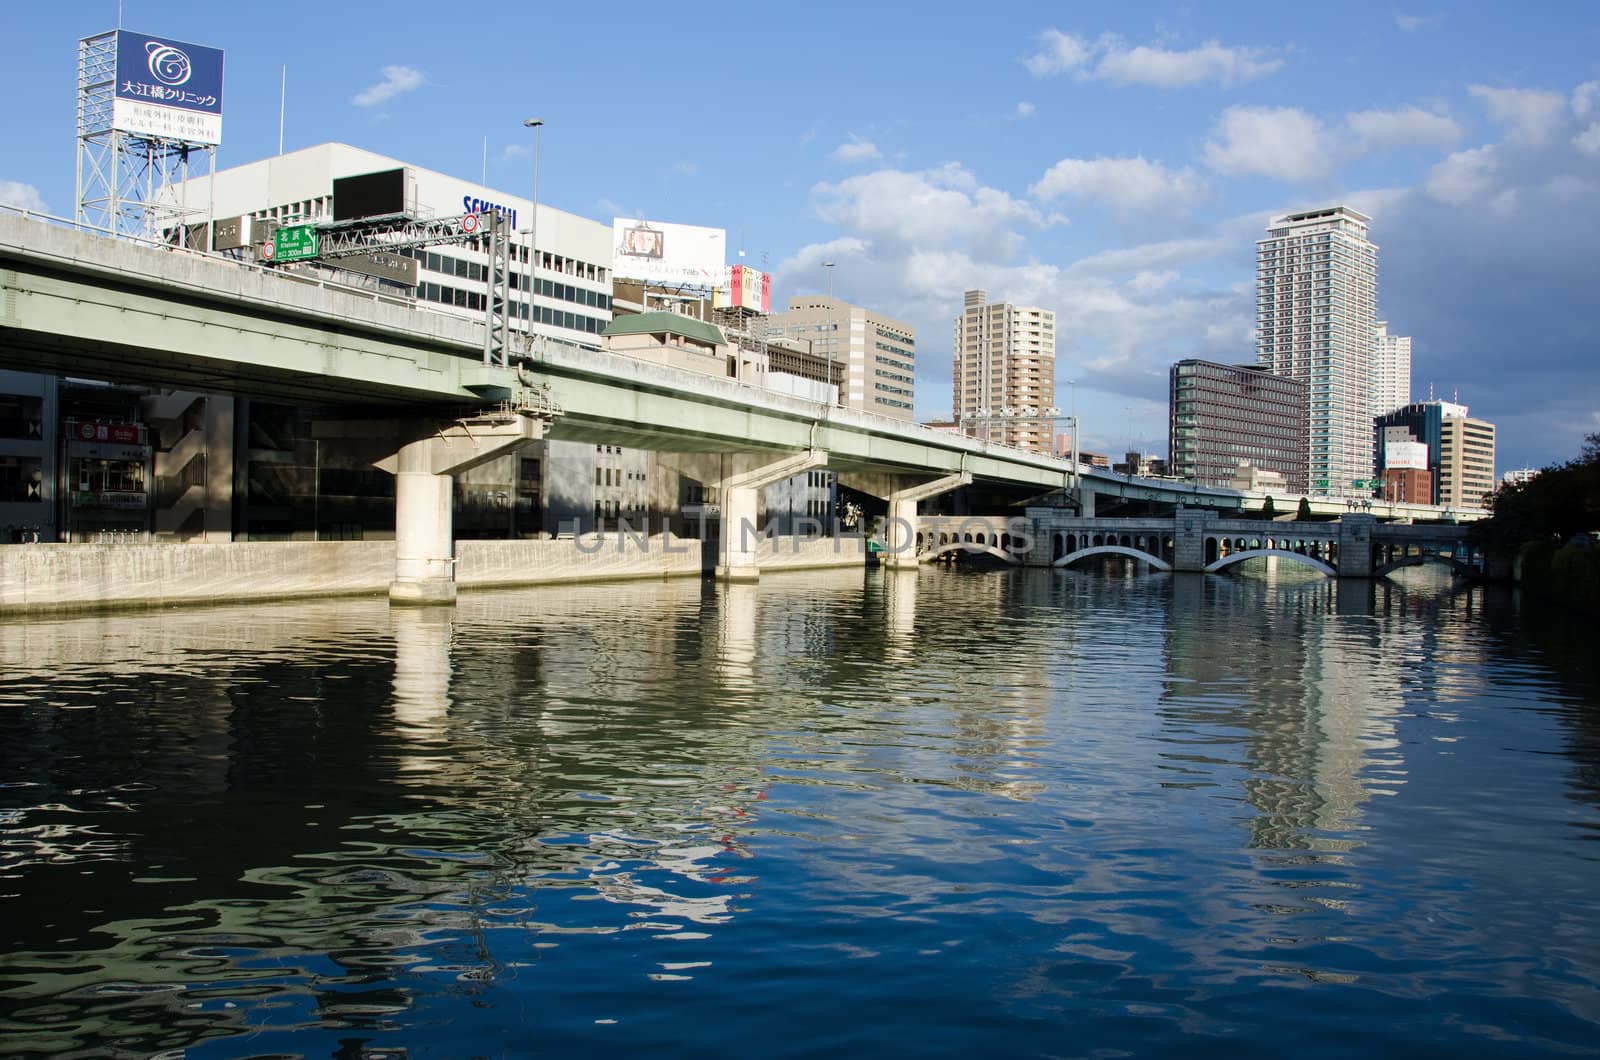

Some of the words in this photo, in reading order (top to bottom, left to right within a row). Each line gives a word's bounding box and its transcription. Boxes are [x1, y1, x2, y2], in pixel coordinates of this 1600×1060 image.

[122, 80, 217, 107] 大江橋クリニック
[463, 195, 517, 230] SEKI
